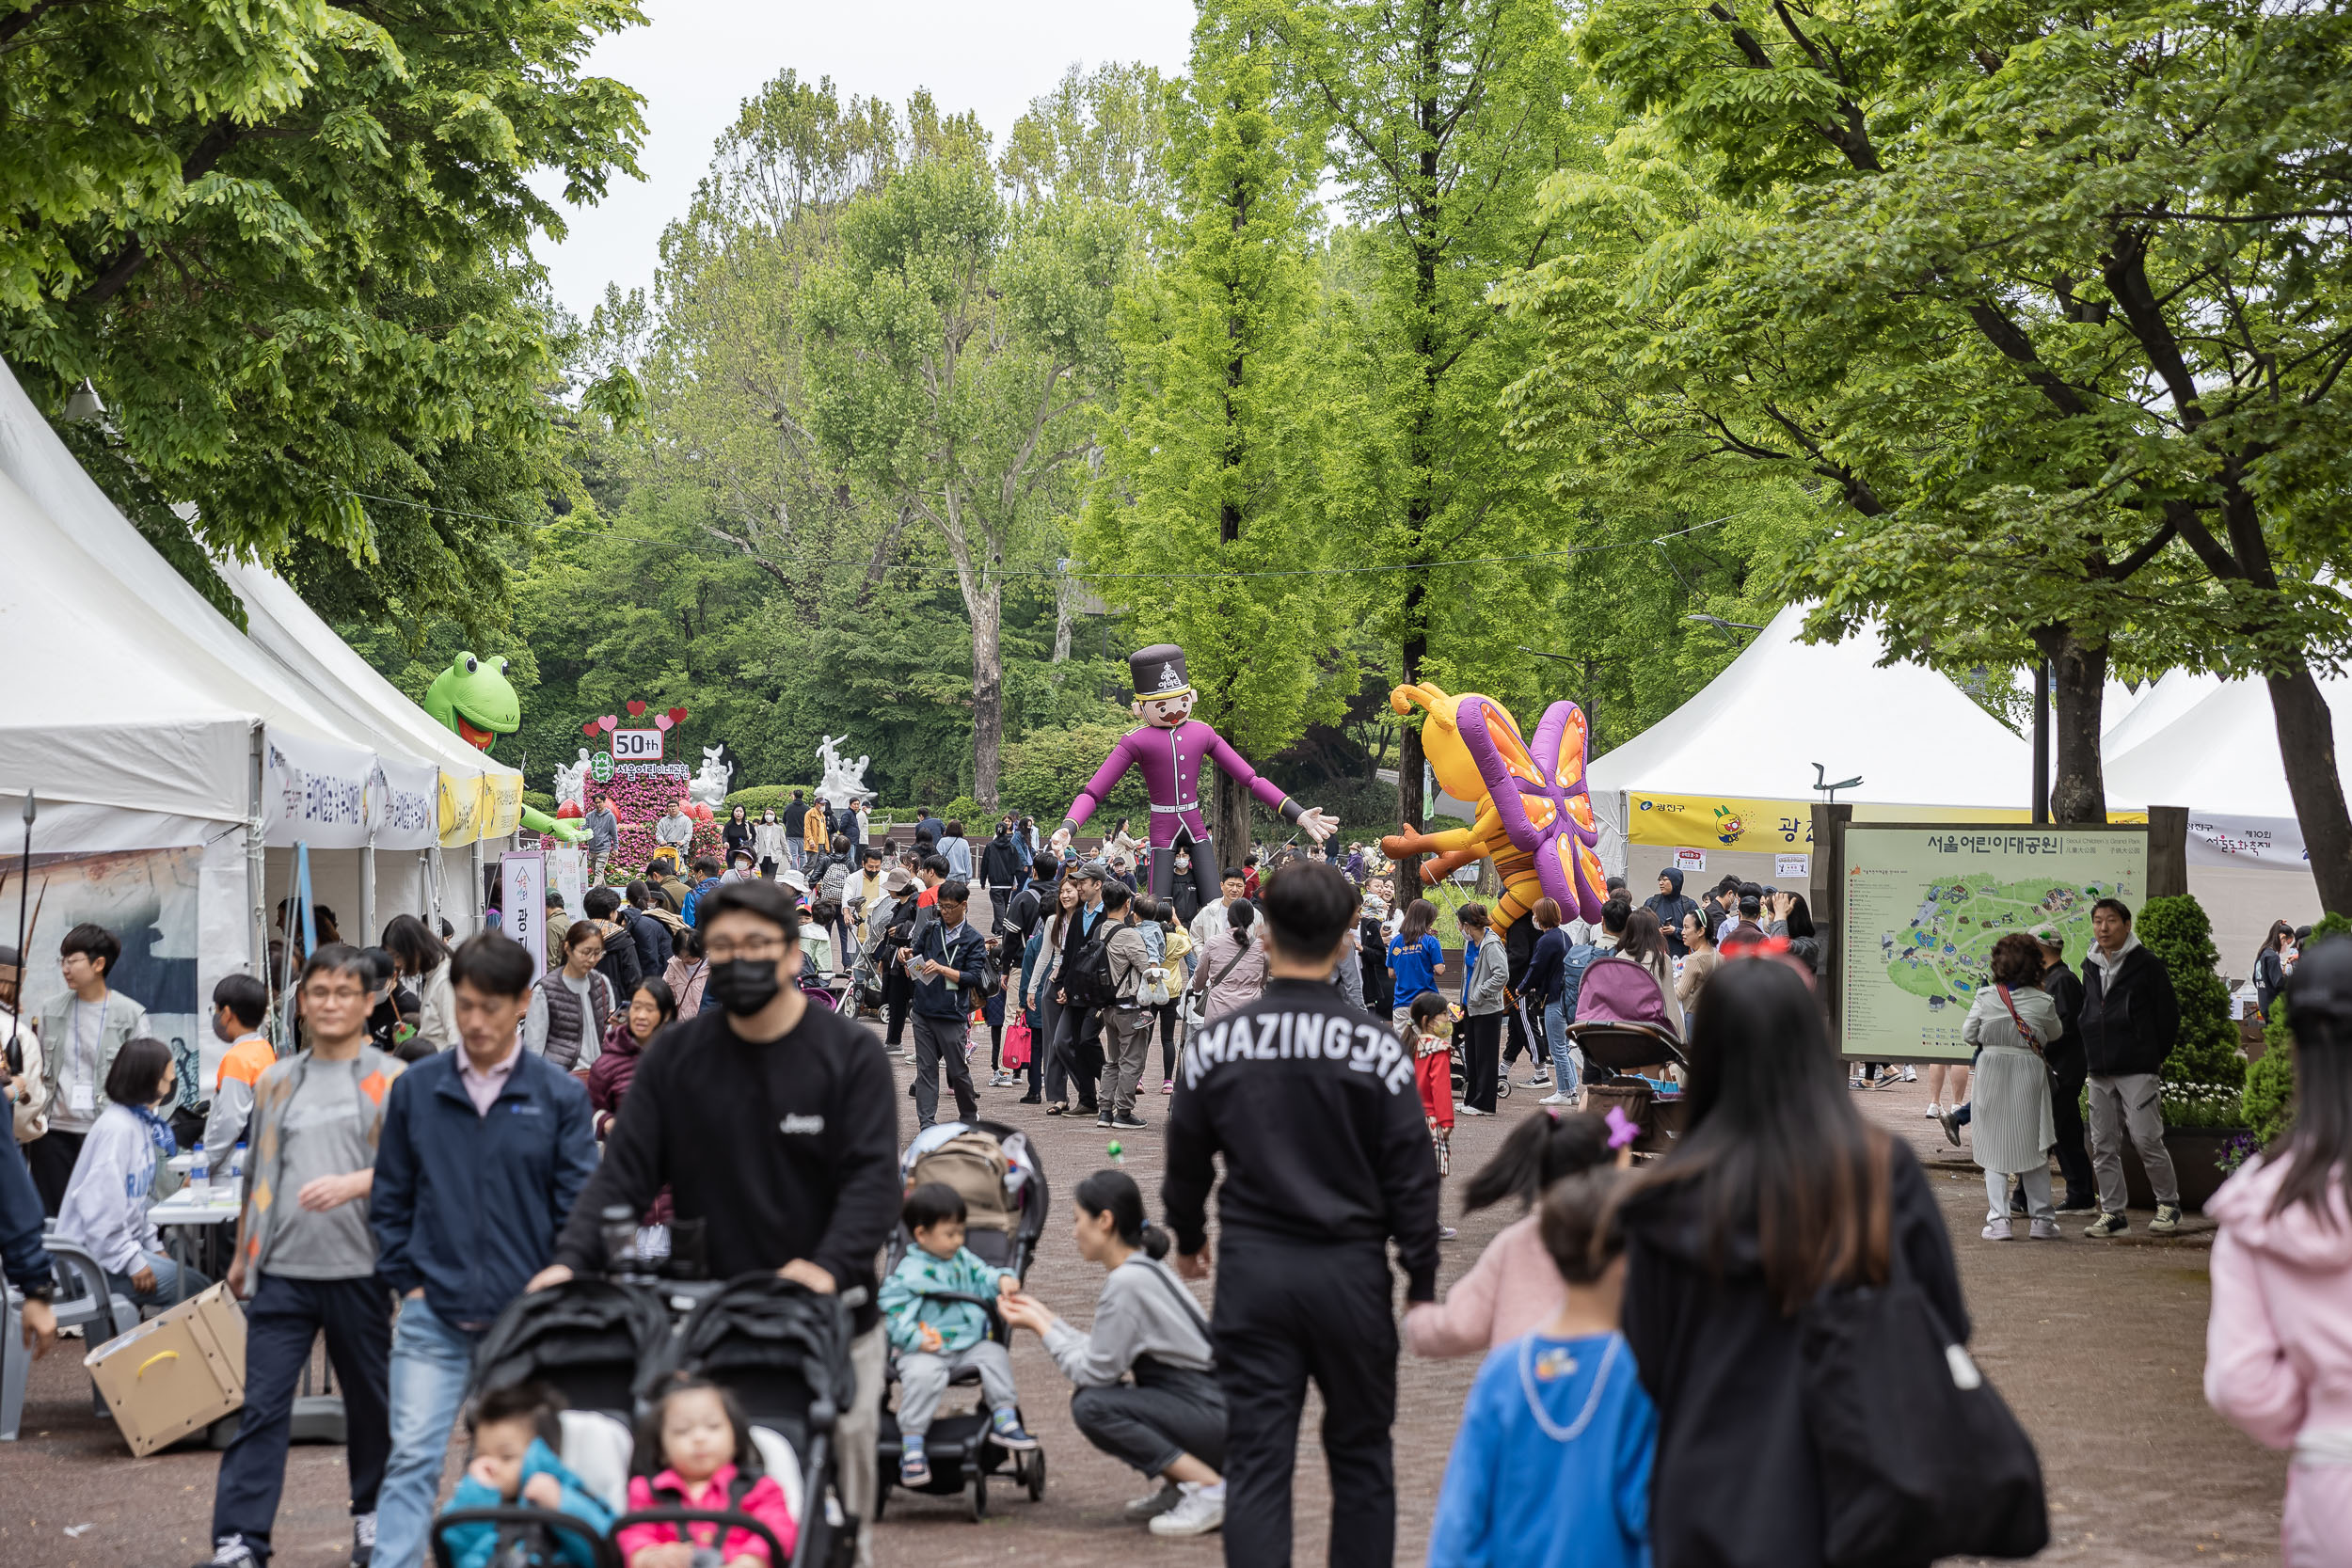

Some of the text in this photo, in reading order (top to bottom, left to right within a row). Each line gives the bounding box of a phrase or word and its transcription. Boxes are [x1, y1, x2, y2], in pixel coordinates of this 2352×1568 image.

[616, 735, 659, 754] 50th
[617, 764, 690, 782] 서울어린이대공원
[1656, 803, 1685, 813] 광진구
[2245, 830, 2271, 839] 제10회
[1928, 835, 2058, 854] 서울어린이대공원
[2205, 834, 2271, 856] 서울동화축제
